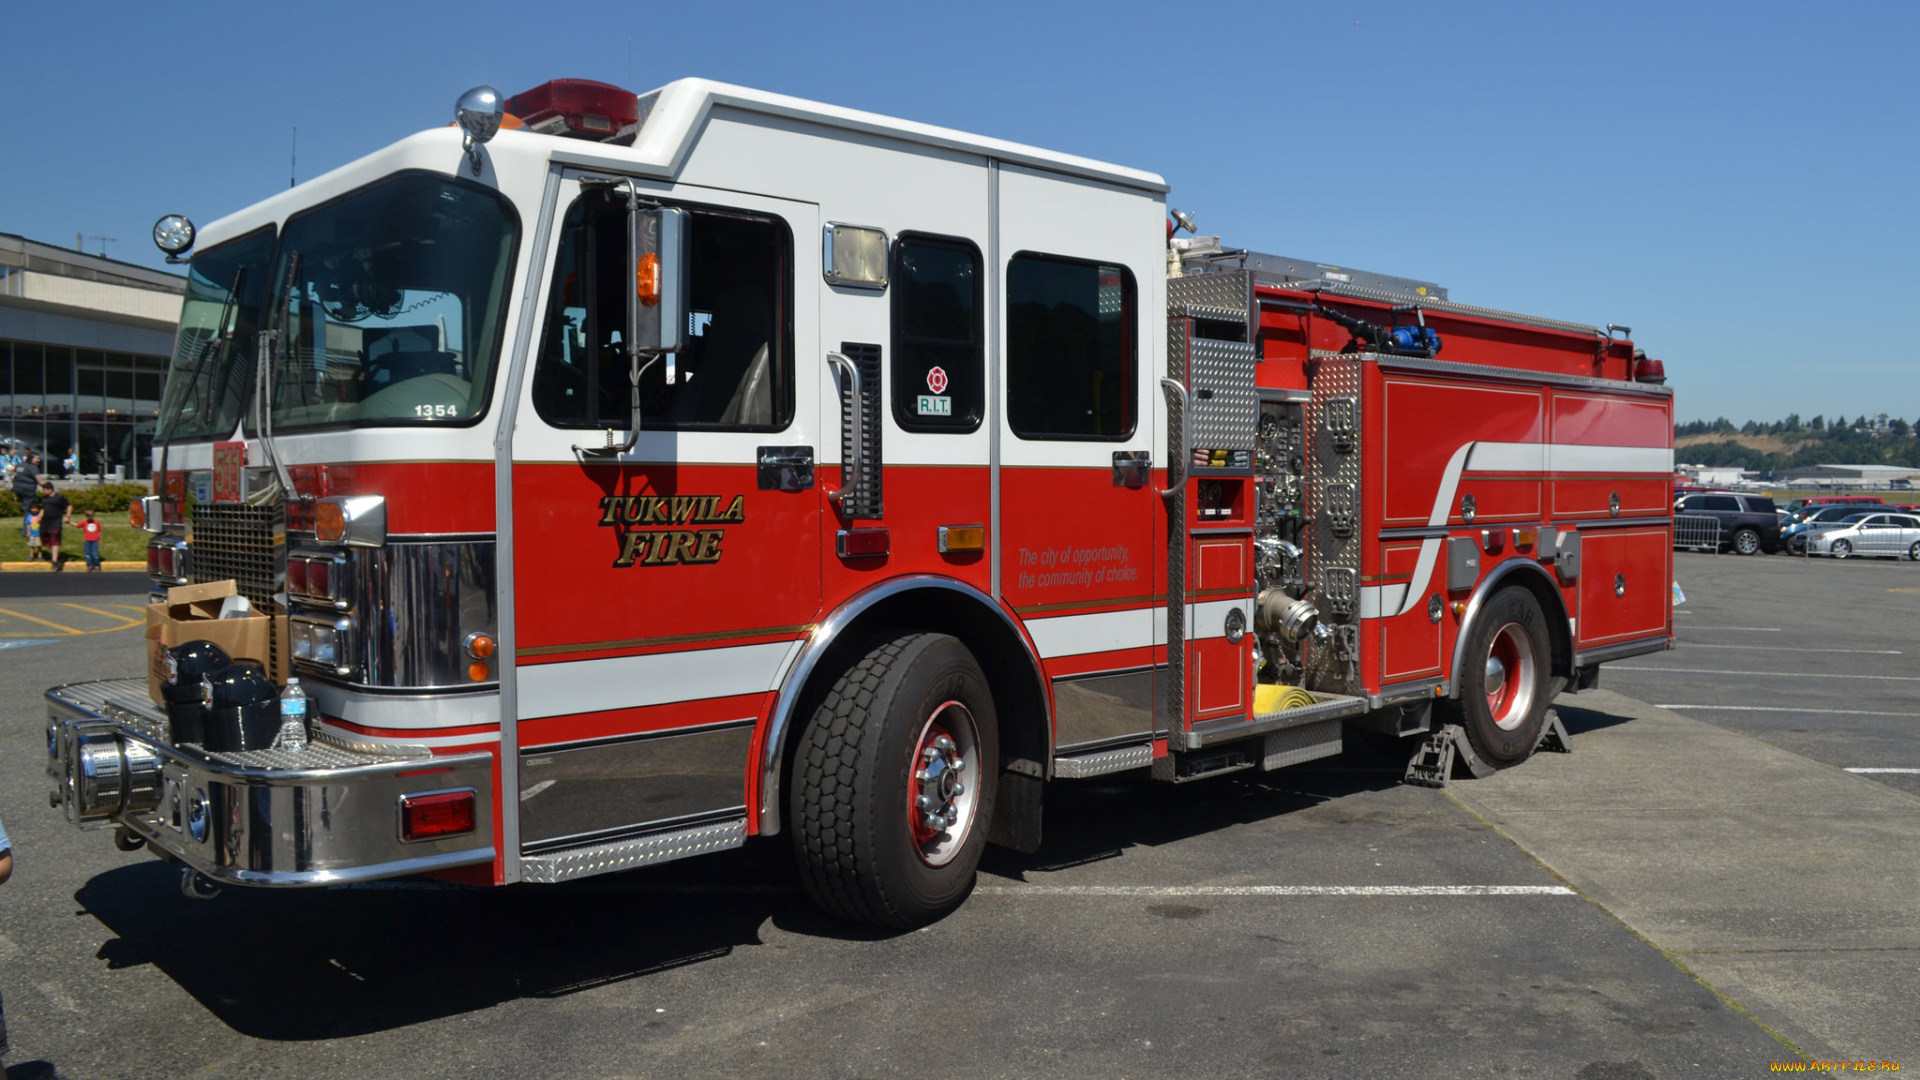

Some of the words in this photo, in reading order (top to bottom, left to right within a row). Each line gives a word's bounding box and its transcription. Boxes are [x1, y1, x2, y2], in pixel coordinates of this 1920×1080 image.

[414, 404, 458, 417] 1354
[920, 398, 948, 413] R.I.T.
[214, 447, 241, 495] 511
[598, 495, 744, 526] TUKWILA
[612, 529, 725, 568] FIRE
[1019, 548, 1038, 566] The
[1040, 546, 1059, 568] city
[1060, 545, 1072, 564] of
[1018, 571, 1035, 589] the
[1037, 568, 1093, 588] community
[1095, 566, 1106, 583] of
